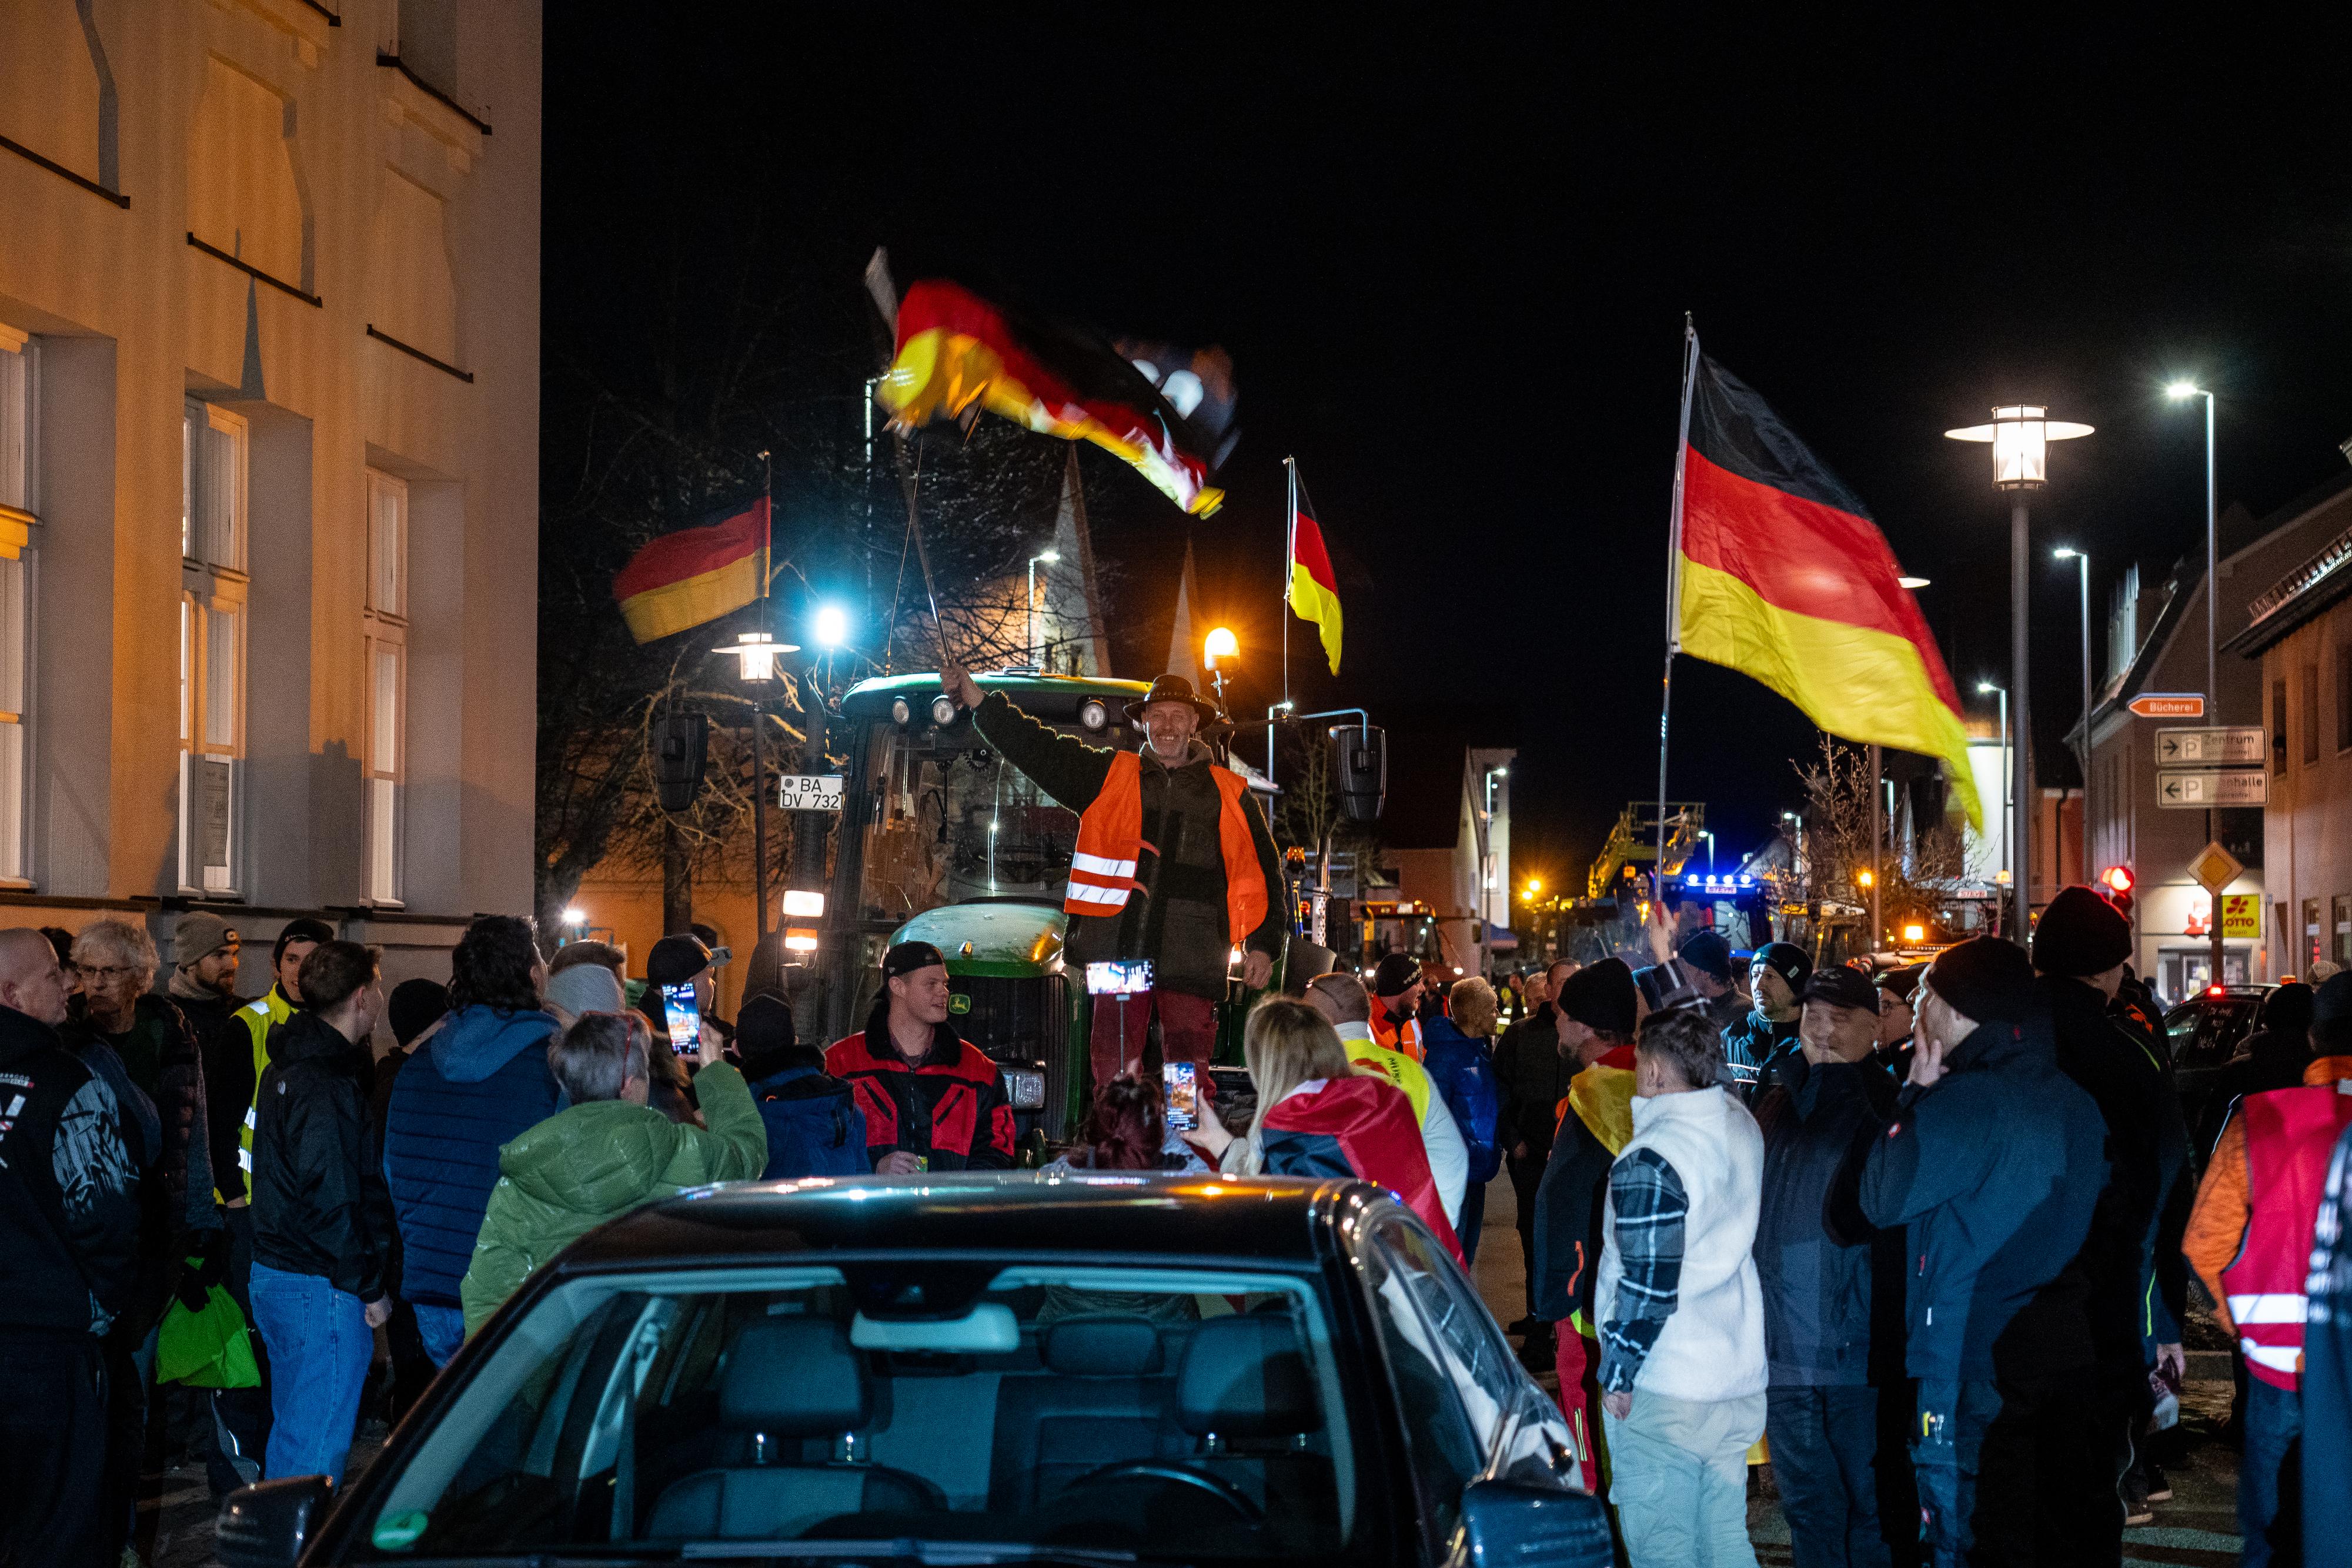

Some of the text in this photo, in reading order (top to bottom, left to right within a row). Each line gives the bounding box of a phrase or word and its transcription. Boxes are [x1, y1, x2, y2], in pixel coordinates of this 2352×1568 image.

[2150, 701, 2193, 713] Bücherei
[2205, 734, 2254, 745] Zentrum
[800, 778, 822, 793] BA
[782, 793, 839, 809] DV 732
[2224, 918, 2254, 927] OTTO
